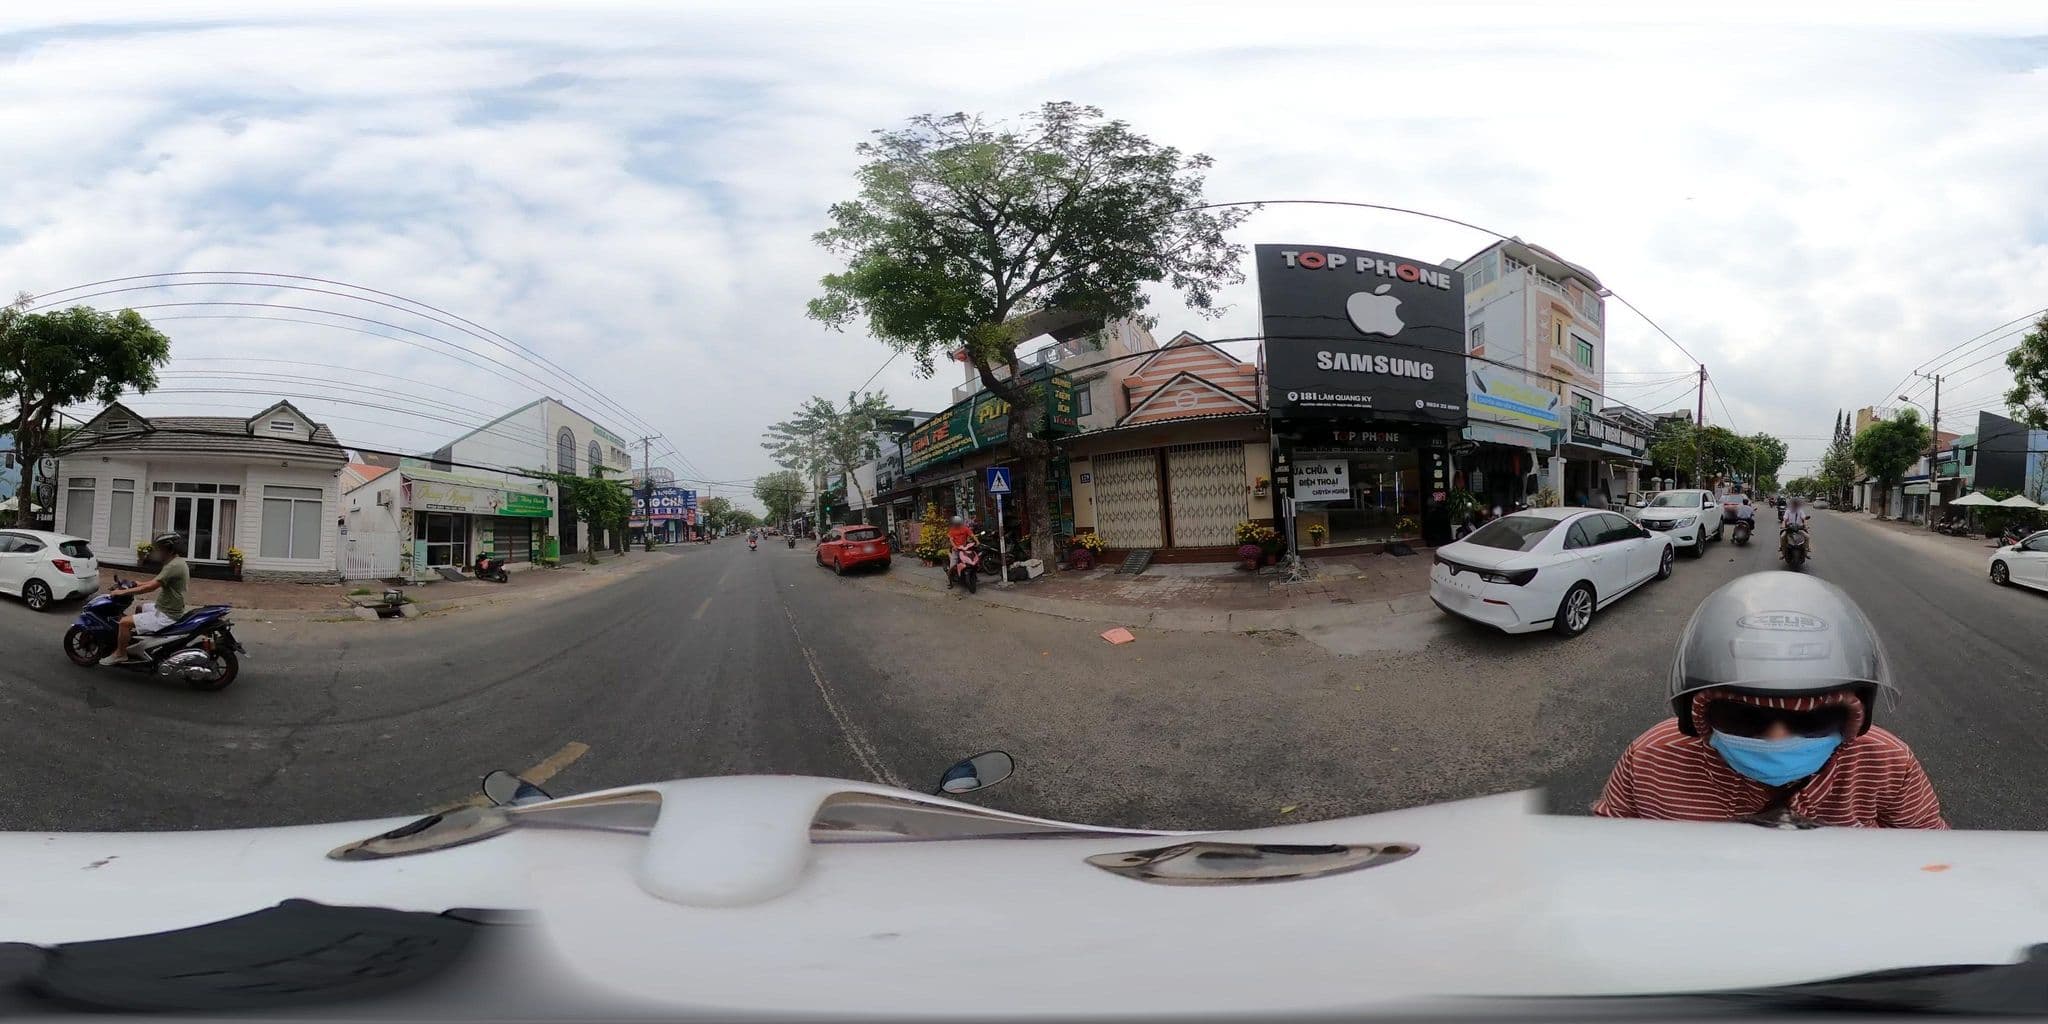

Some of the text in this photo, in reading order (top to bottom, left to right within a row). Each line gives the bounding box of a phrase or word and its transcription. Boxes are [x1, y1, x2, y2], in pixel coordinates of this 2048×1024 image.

[1281, 251, 1450, 291] TOP PHONE
[1317, 351, 1434, 380] SAMSUNG
[1300, 392, 1317, 401] 181
[1335, 394, 1361, 402] QUANG
[1361, 395, 1373, 403] KY
[1332, 431, 1399, 442] TOP PHONE
[1305, 464, 1328, 475] CHỮA
